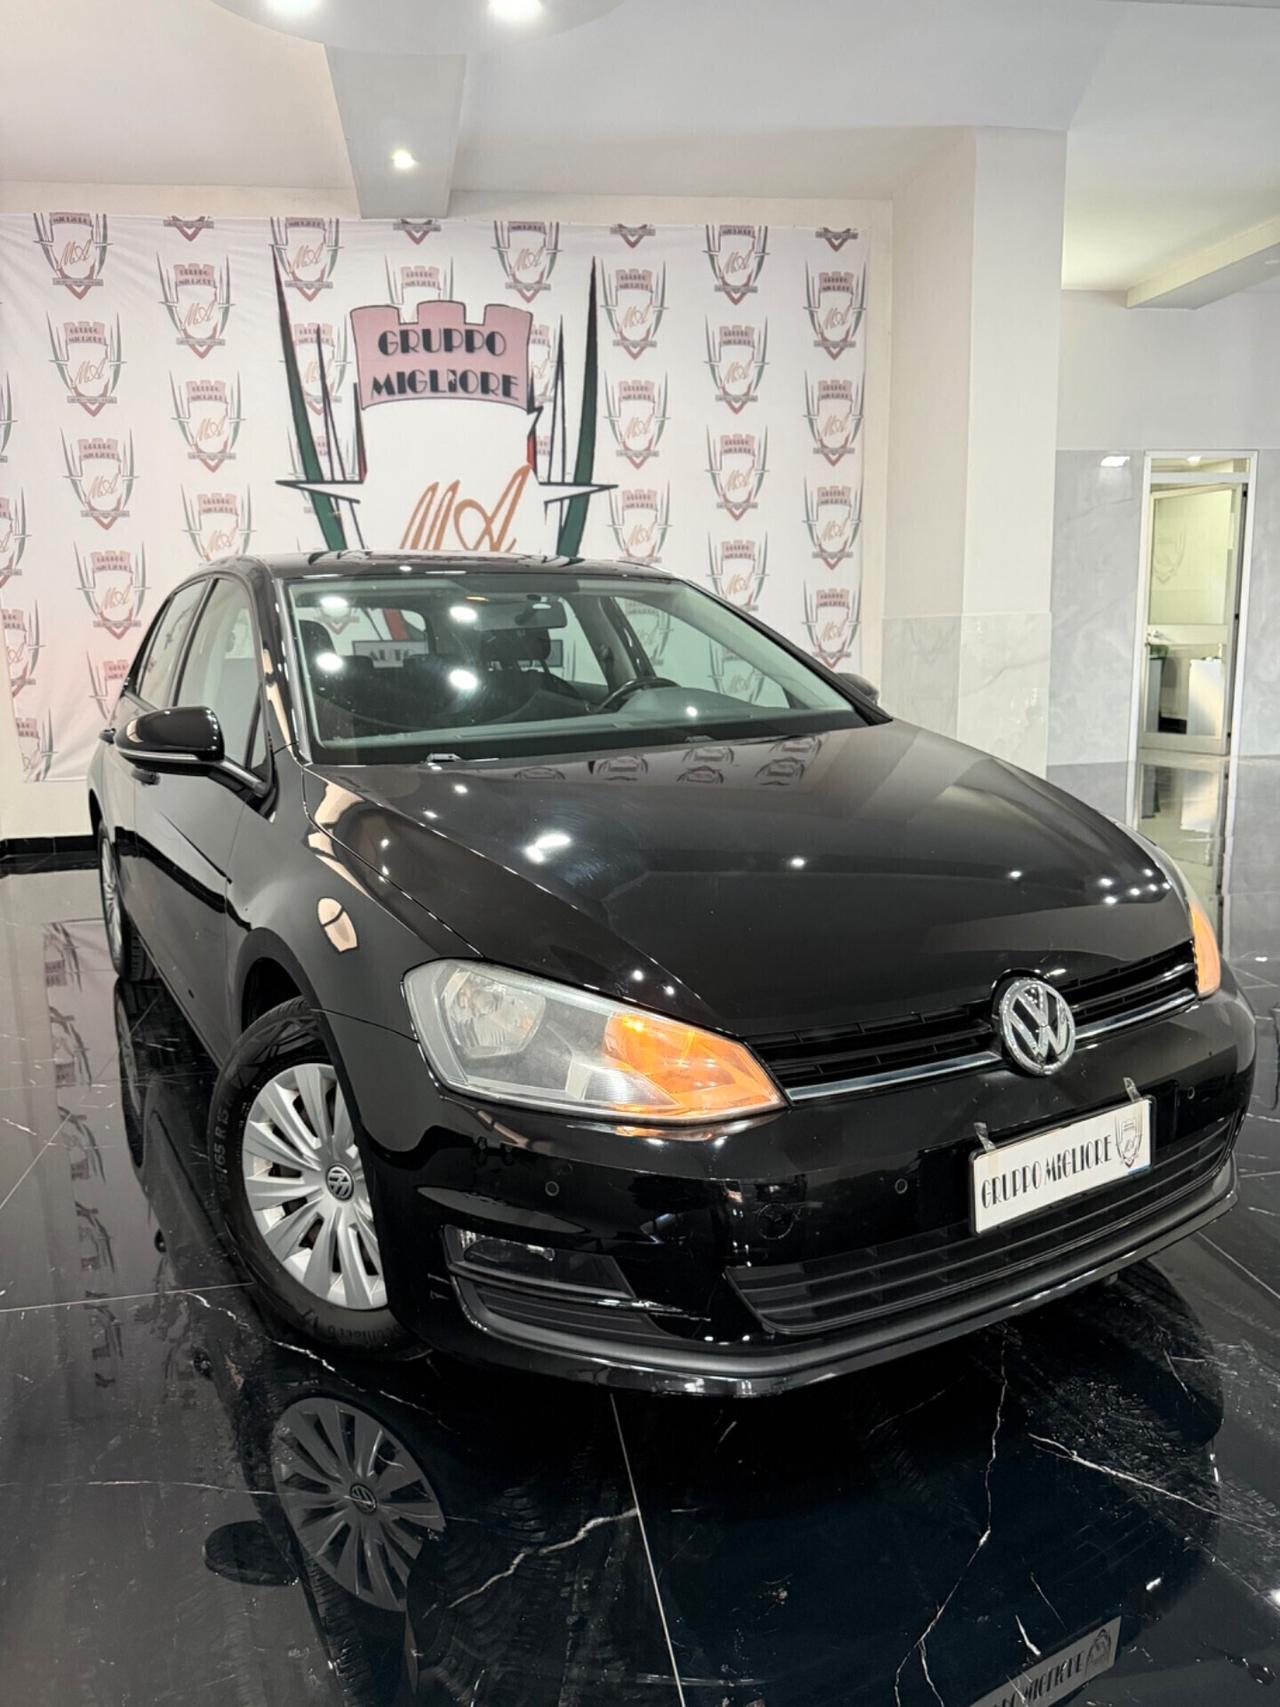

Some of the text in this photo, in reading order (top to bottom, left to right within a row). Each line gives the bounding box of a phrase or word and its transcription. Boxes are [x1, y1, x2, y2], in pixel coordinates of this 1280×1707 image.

[378, 327, 507, 357] GRUPPO
[370, 369, 519, 400] MIGLIORE
[981, 1134, 1113, 1209] GRUPPO MIGLIORE
